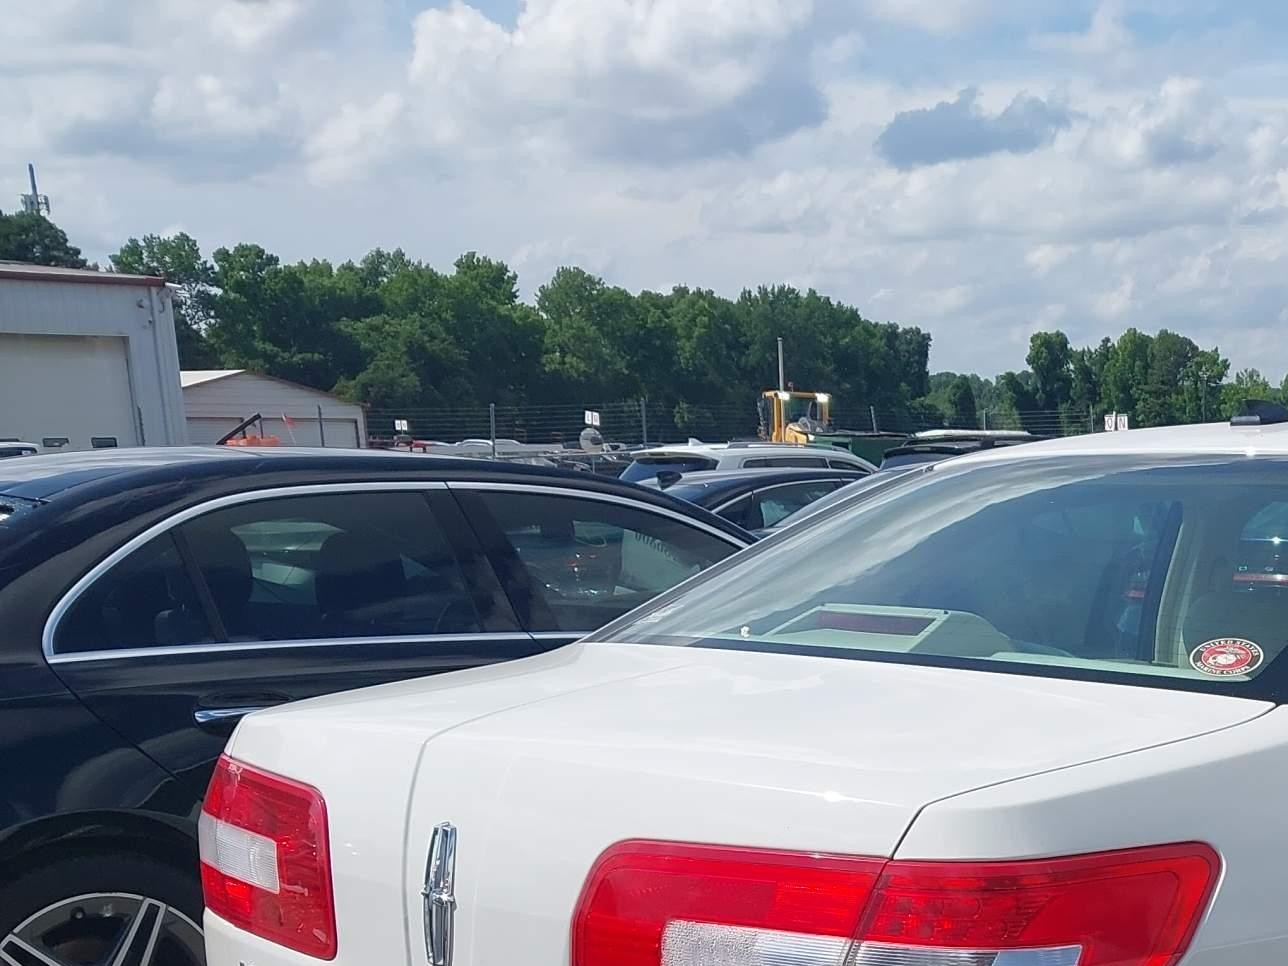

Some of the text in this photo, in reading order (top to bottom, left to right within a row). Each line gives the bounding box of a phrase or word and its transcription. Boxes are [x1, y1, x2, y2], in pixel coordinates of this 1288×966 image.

[1200, 640, 1259, 656] UNITED STATES
[1196, 661, 1250, 675] MARINE CORPS
